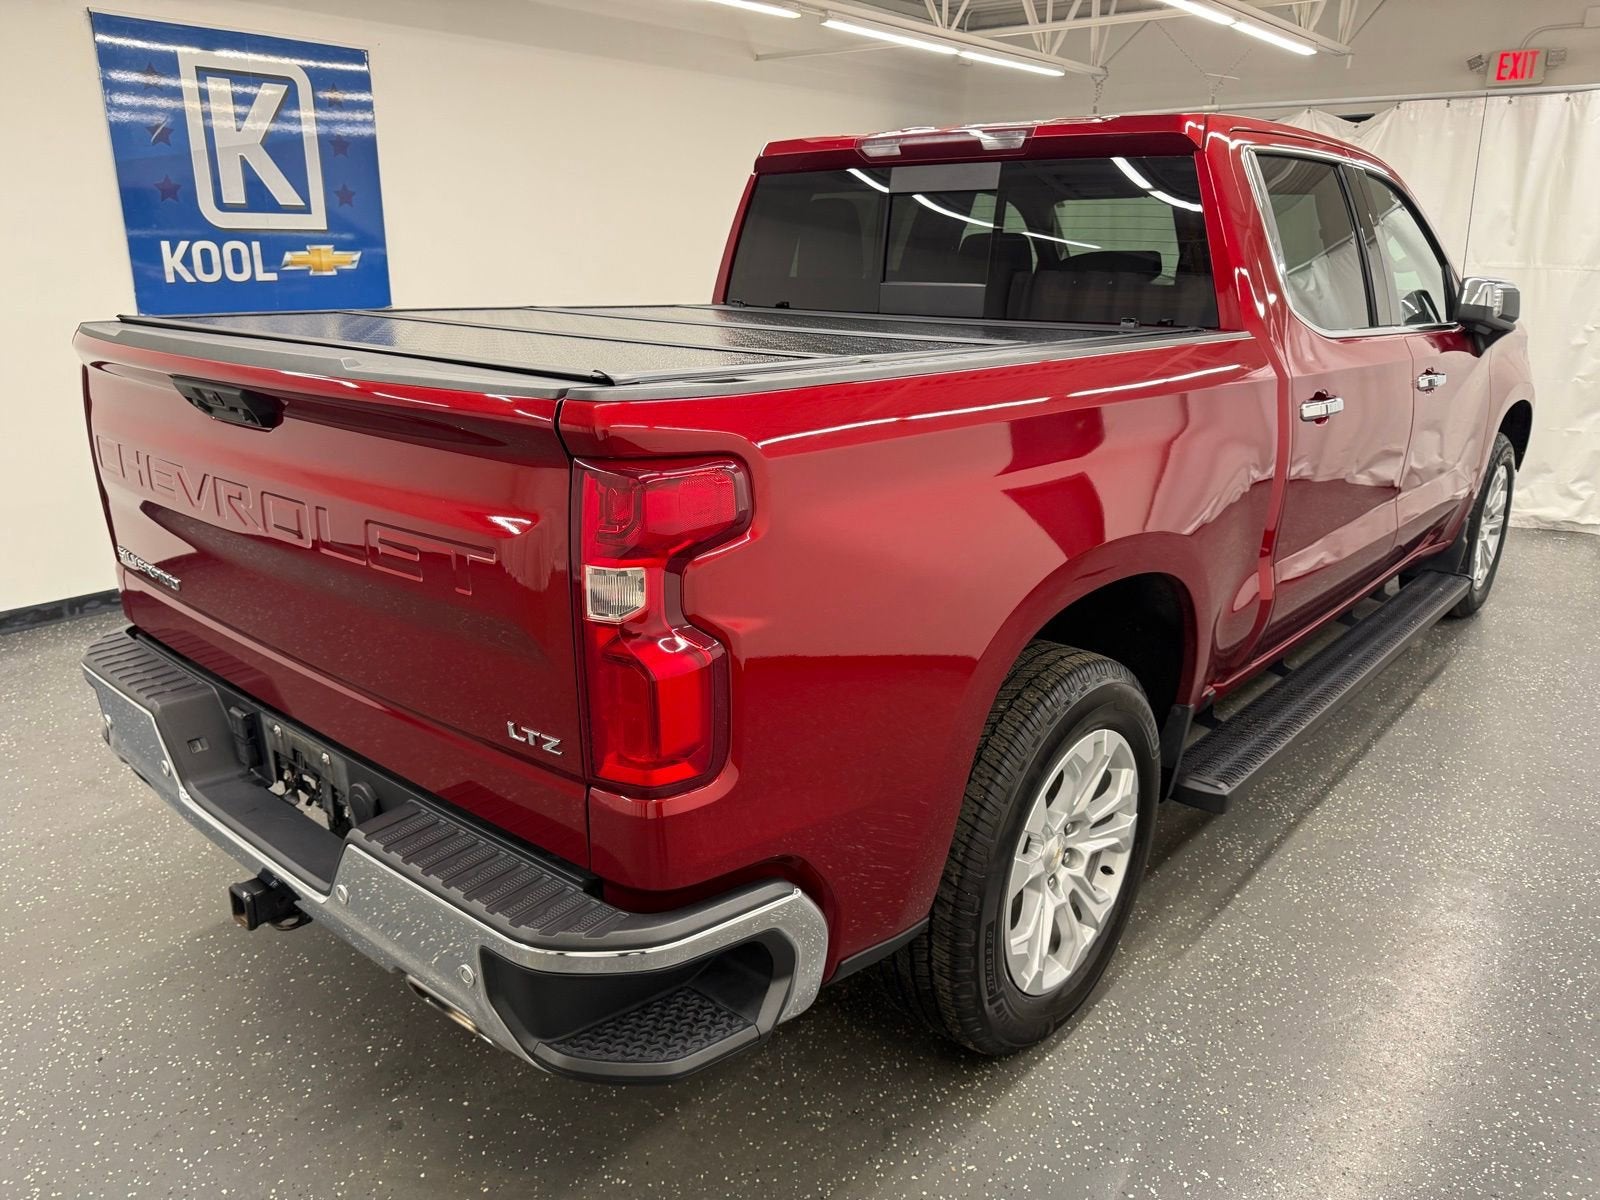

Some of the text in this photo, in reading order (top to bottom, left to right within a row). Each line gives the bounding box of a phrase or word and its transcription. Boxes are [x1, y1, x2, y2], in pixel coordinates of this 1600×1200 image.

[1496, 50, 1540, 81] EXIT
[206, 76, 306, 207] K
[160, 240, 278, 283] KOOL
[96, 435, 496, 596] CHEVROLET
[507, 720, 563, 755] LTZ
